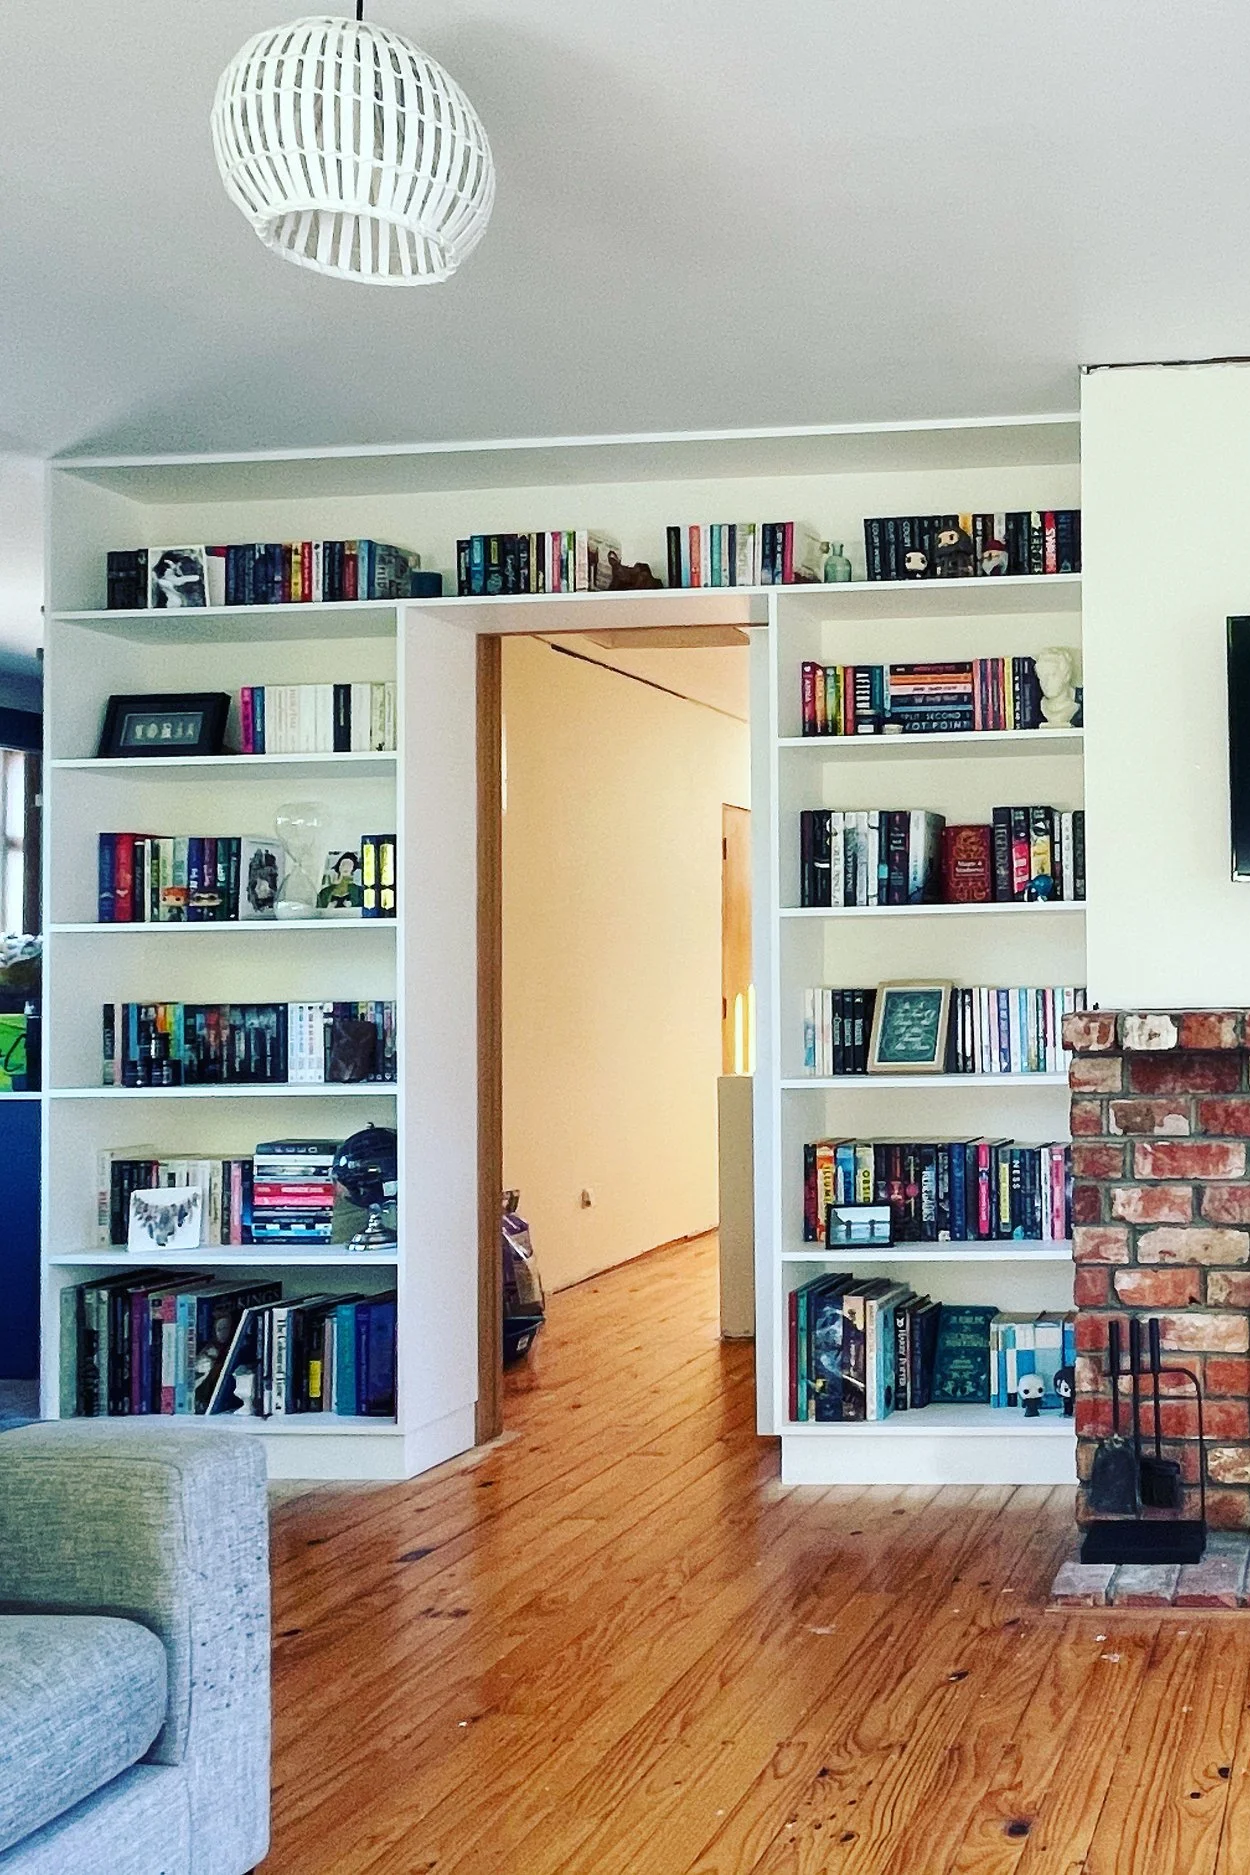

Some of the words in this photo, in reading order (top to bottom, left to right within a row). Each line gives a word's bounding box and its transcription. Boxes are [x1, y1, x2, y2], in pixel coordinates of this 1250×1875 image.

[926, 711, 961, 721] SECOND
[932, 720, 971, 731] POINT
[1012, 1160, 1021, 1190] NESS
